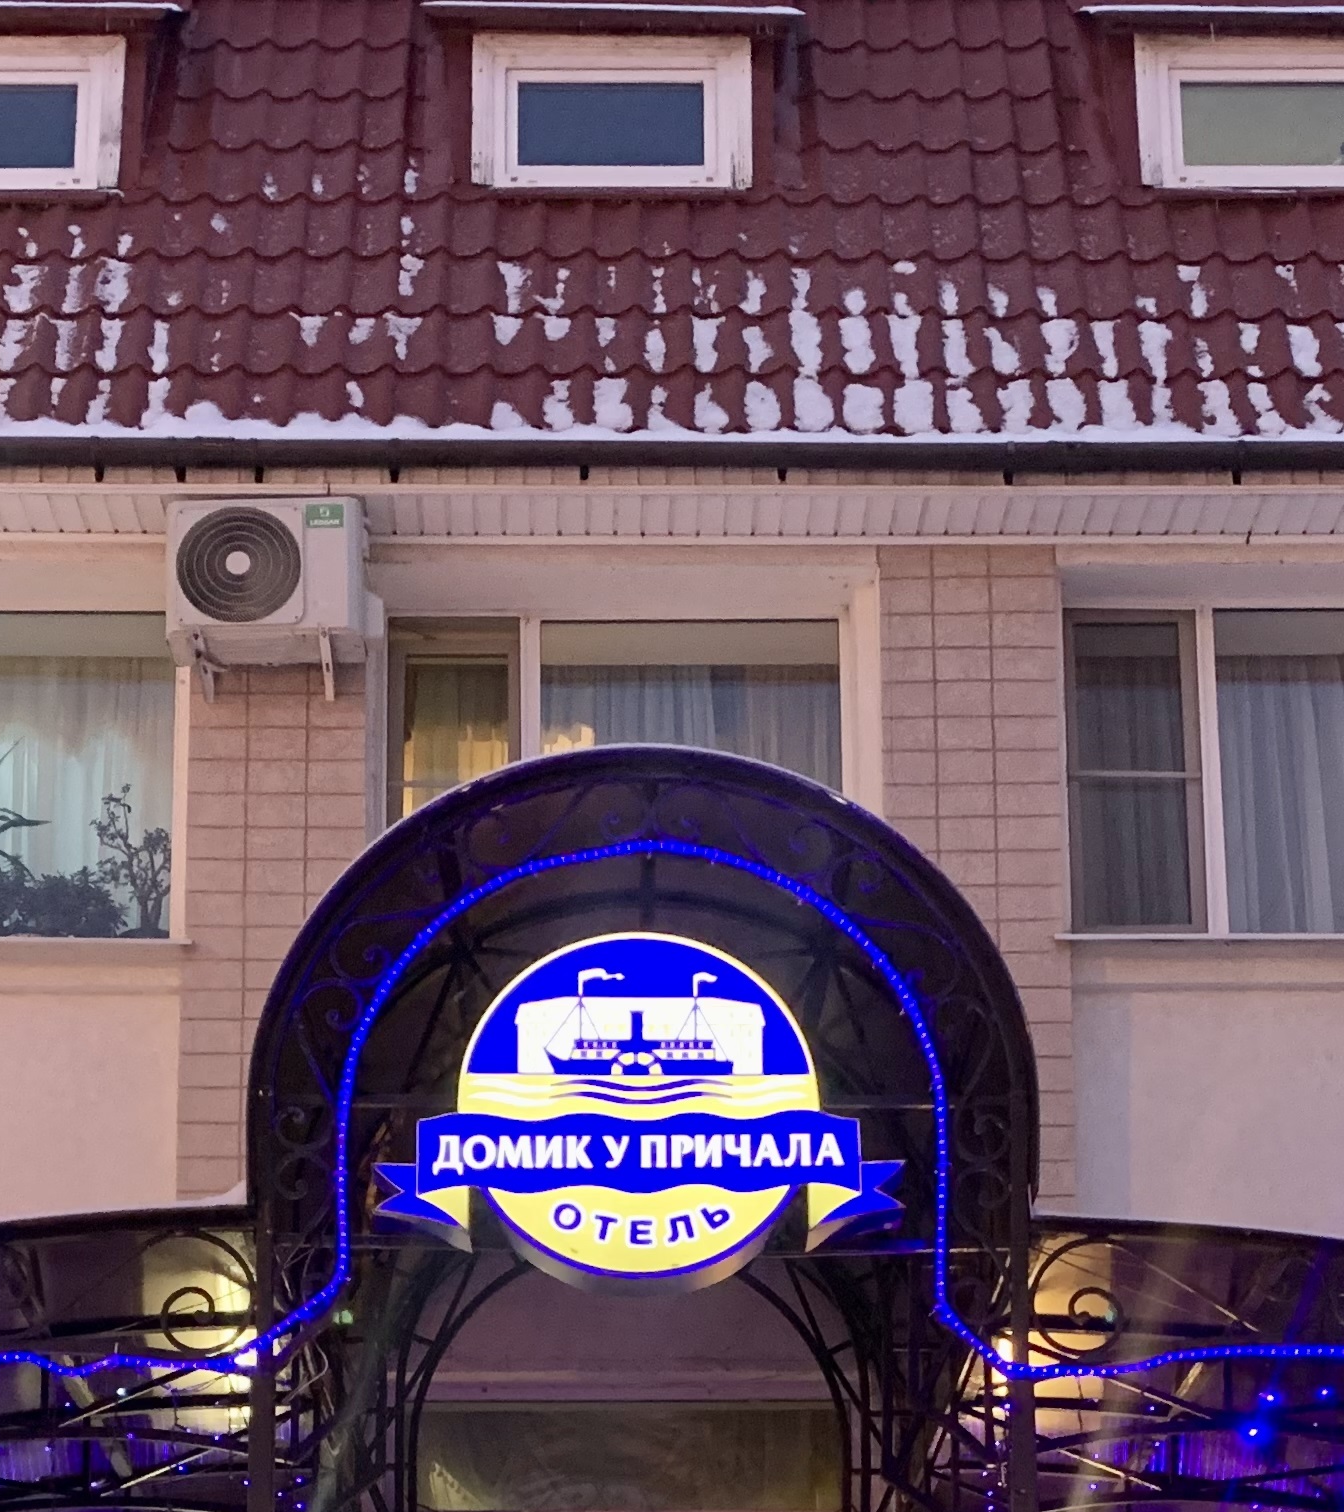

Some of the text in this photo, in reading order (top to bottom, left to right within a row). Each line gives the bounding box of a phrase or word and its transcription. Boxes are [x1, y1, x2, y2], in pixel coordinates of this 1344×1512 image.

[431, 1132, 845, 1175] ДОМИК У ПРИЧАЛА
[553, 1202, 732, 1246] ОТЕЛЬ
